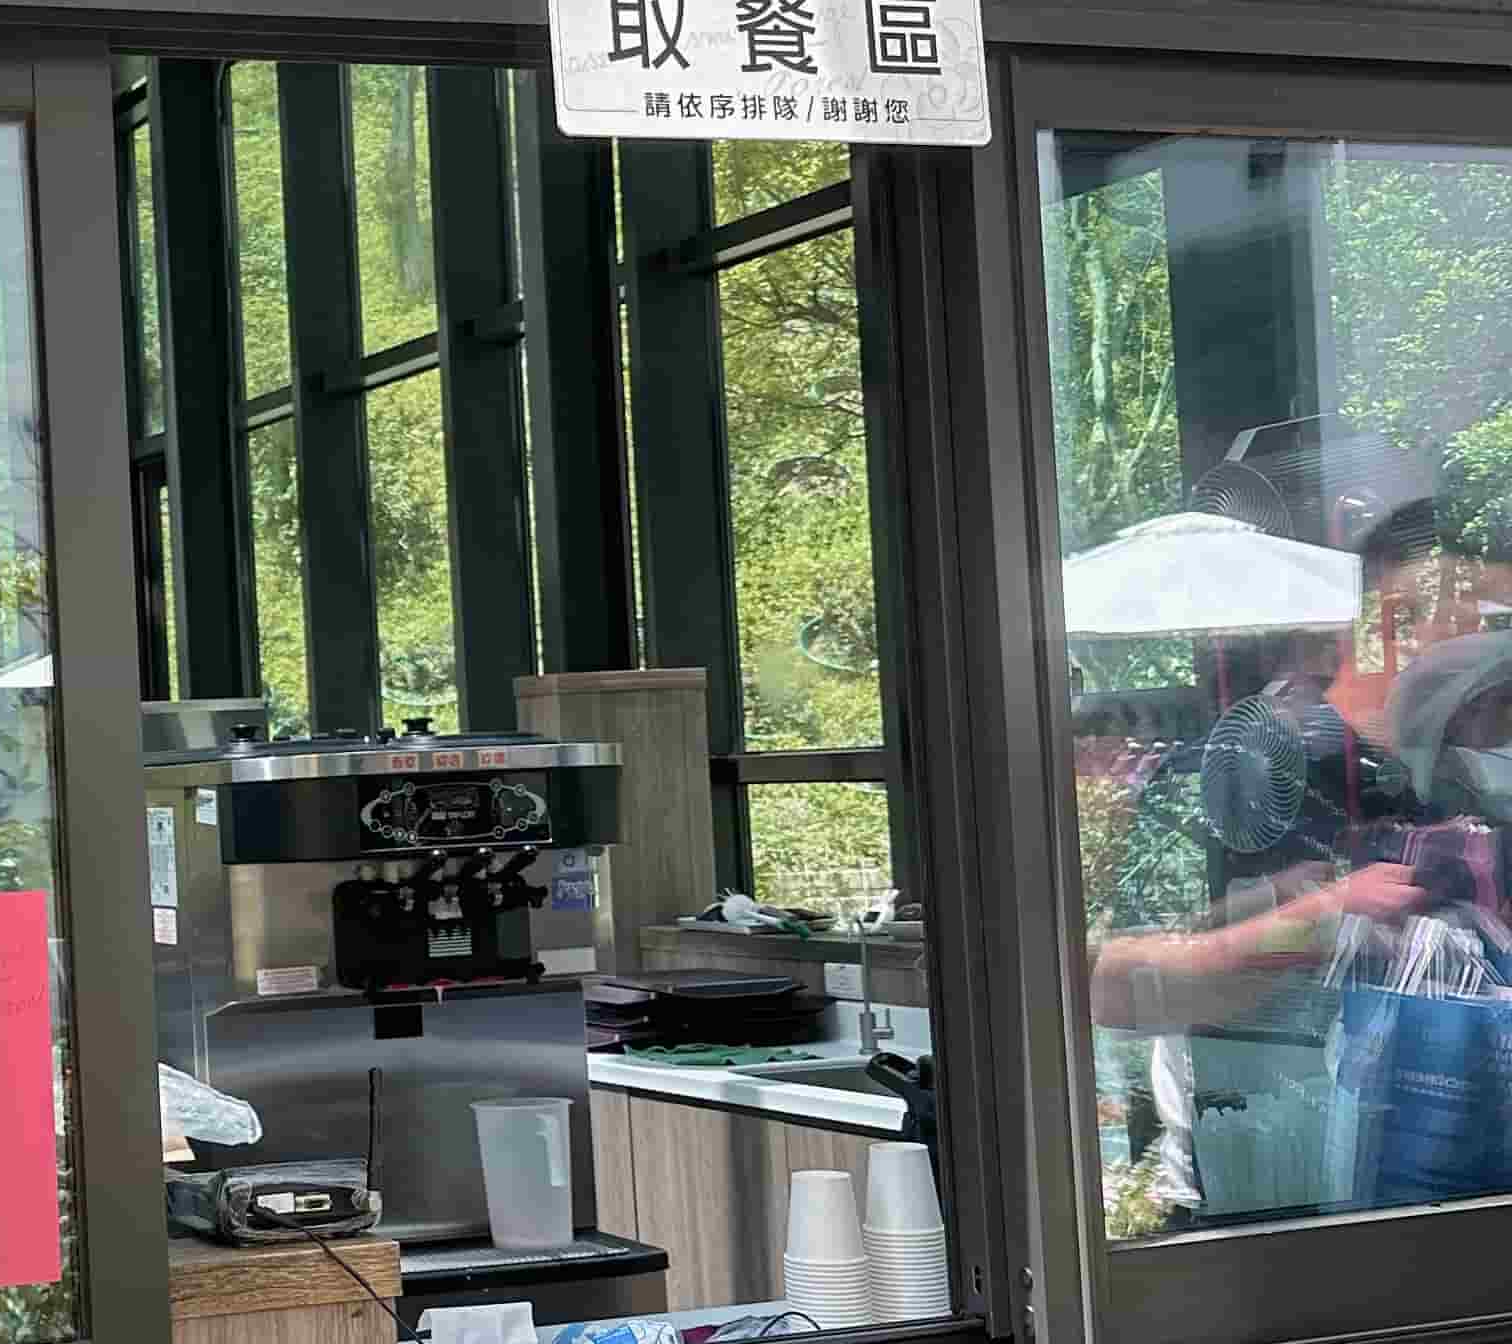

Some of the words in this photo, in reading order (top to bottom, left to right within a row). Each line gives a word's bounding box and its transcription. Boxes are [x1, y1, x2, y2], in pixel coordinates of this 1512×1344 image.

[645, 92, 911, 125] 請依序排隊/謝謝您
